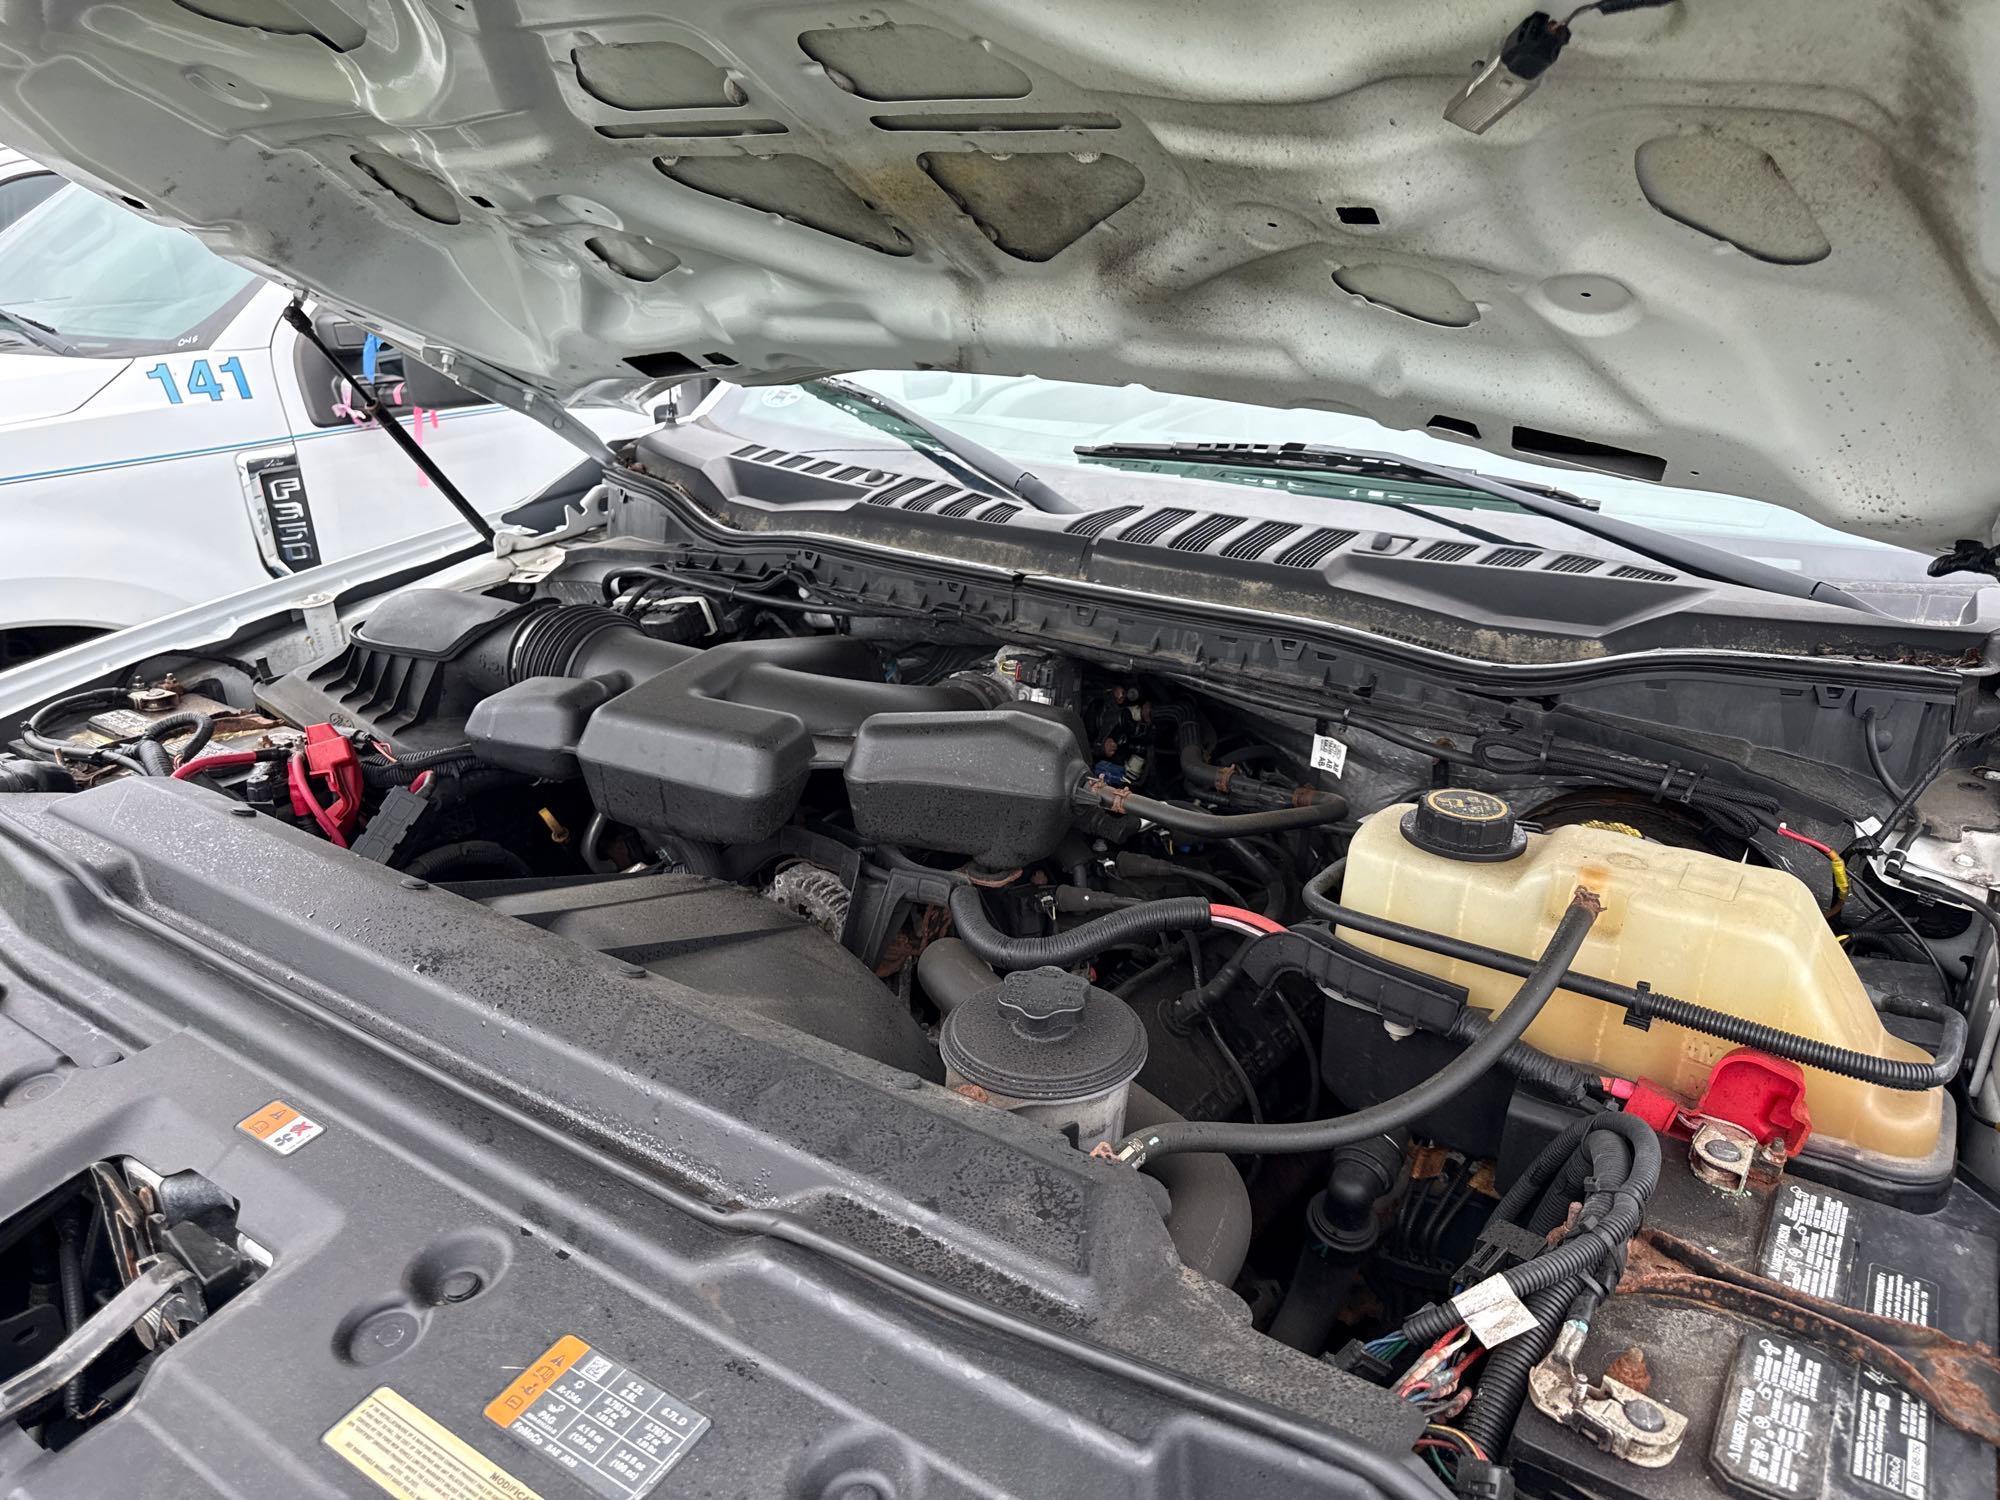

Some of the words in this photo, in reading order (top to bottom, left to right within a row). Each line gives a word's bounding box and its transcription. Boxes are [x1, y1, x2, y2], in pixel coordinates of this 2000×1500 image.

[146, 356, 253, 404] 141
[537, 1410, 556, 1424] PAG
[511, 1421, 543, 1445] FoMoCo
